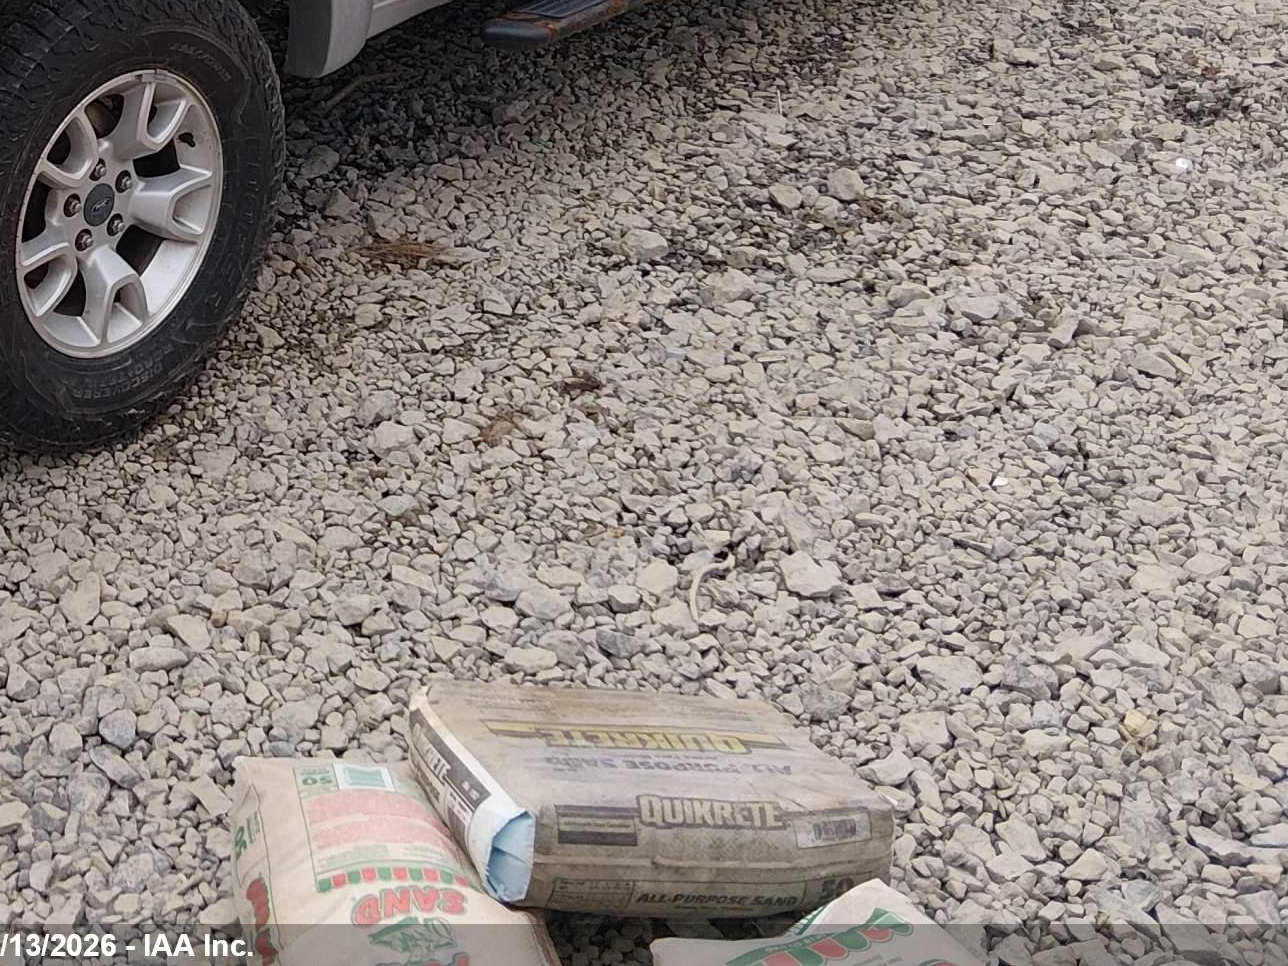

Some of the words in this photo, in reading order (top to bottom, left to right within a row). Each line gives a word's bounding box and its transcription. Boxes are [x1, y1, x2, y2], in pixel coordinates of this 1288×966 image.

[638, 794, 787, 830] QUIKRETE
[352, 885, 468, 927] SAND
[752, 894, 799, 907] SAND
